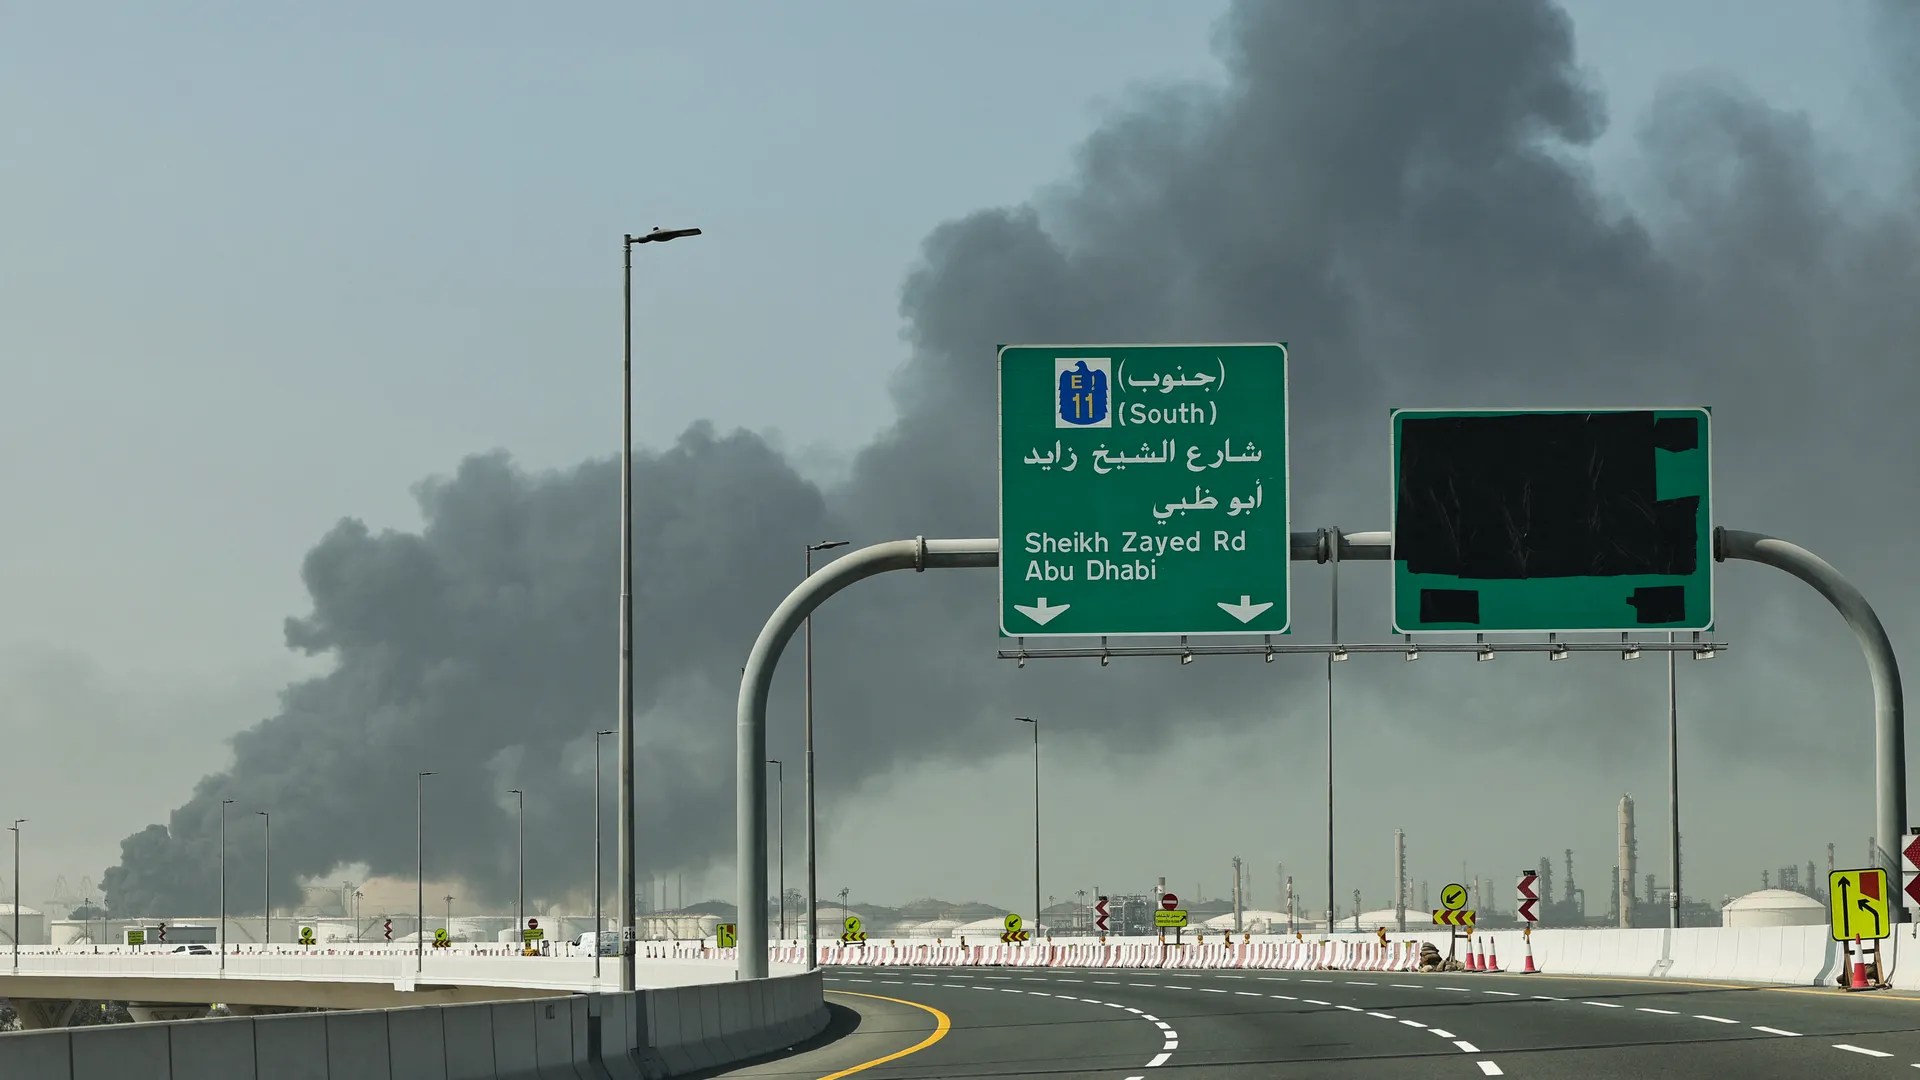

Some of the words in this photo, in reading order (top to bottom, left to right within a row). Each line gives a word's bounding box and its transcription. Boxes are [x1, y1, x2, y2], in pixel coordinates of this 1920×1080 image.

[1071, 375, 1083, 389] E
[1118, 357, 1225, 394] (جنوب)
[1072, 393, 1093, 419] 11
[1118, 401, 1217, 426] (South)
[1023, 440, 1078, 472] زايد
[1092, 438, 1175, 474] الشيخ
[1187, 438, 1262, 472] شارع
[1153, 485, 1218, 525] ظبي
[1227, 479, 1263, 516] أبو
[1025, 531, 1109, 553] Sheikh
[1122, 531, 1200, 556] Zayed
[1214, 530, 1246, 551] Rd
[1025, 560, 1074, 581] Abu
[1086, 559, 1156, 580] Dhabi
